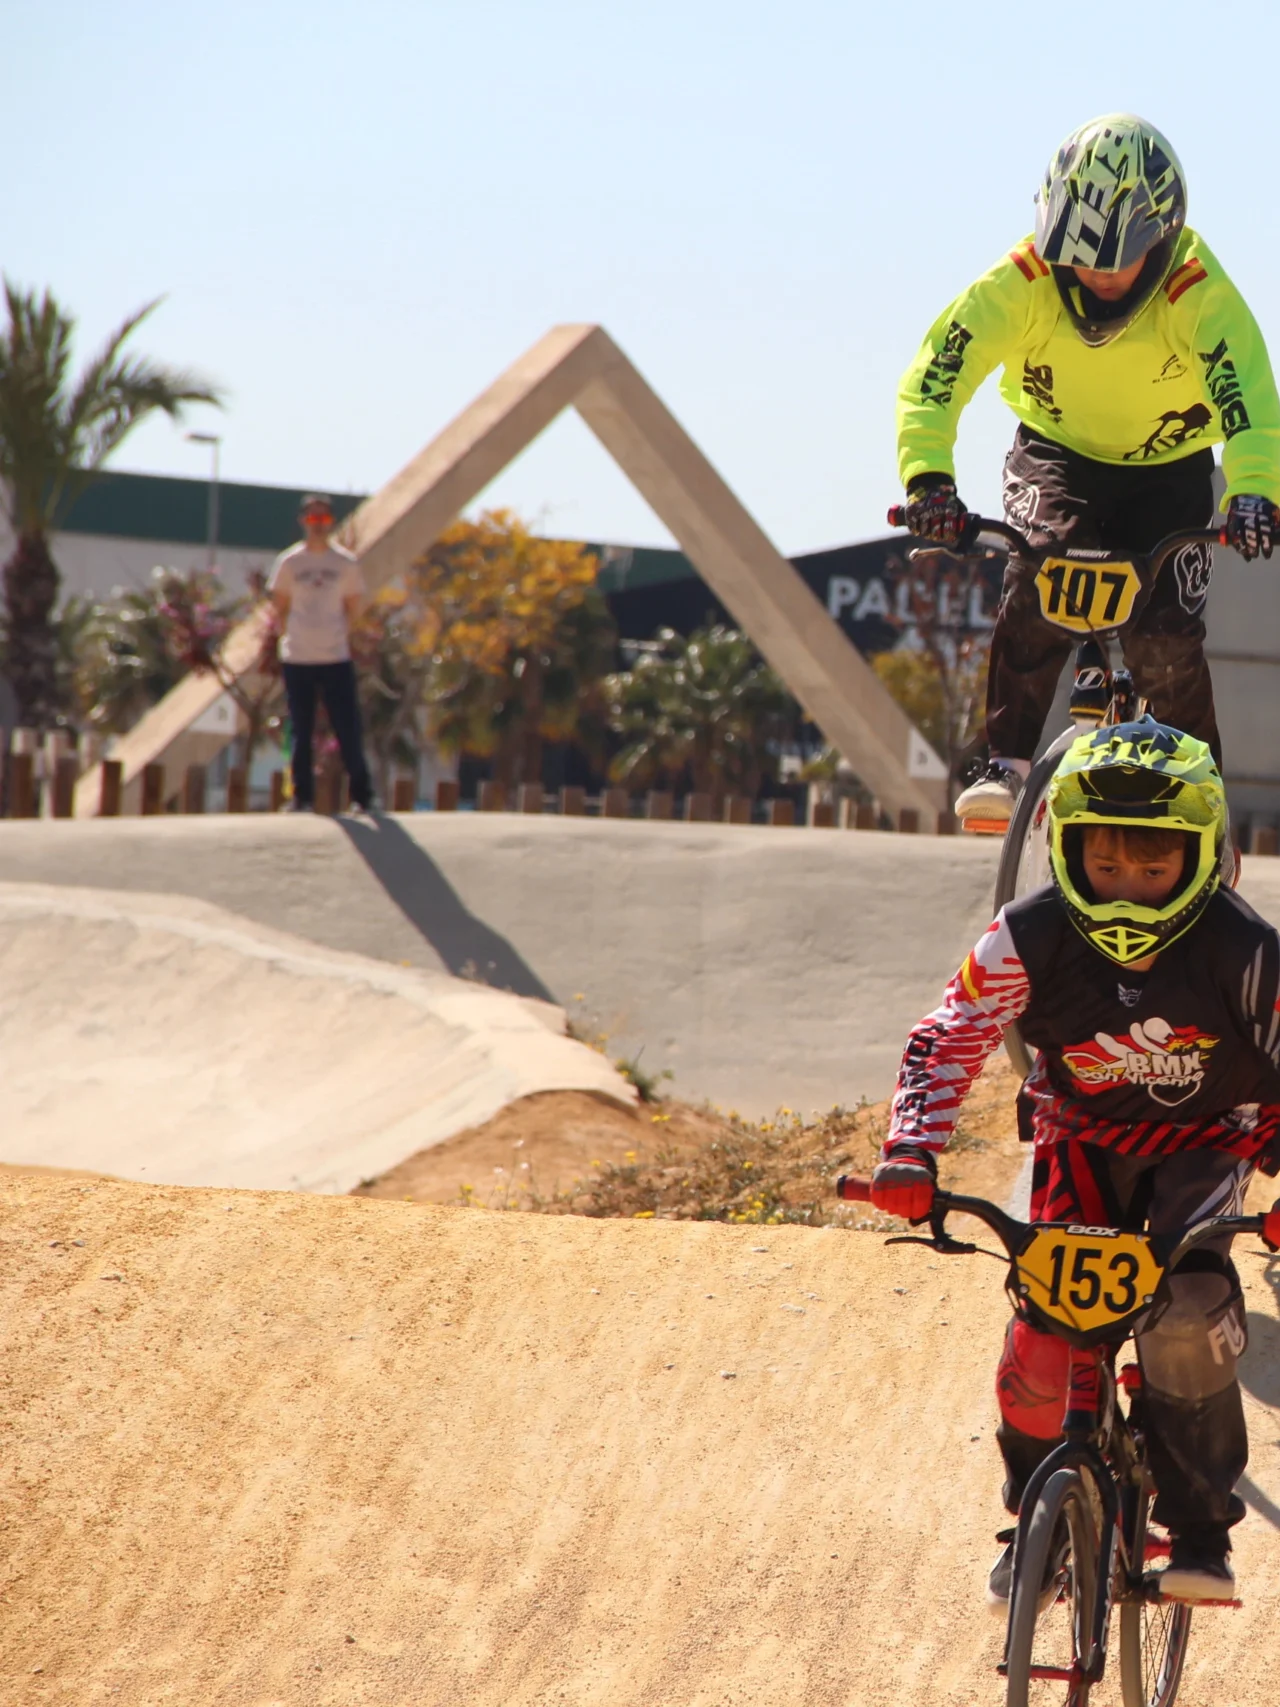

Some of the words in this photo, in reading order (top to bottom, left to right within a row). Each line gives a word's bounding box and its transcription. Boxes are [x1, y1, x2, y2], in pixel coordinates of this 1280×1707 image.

[1197, 337, 1252, 442] BMX
[1046, 565, 1129, 622] 107
[1122, 1070, 1206, 1088] Vicente
[1126, 1050, 1204, 1077] BMX
[1066, 1225, 1120, 1237] BOX
[1048, 1245, 1140, 1314] 153
